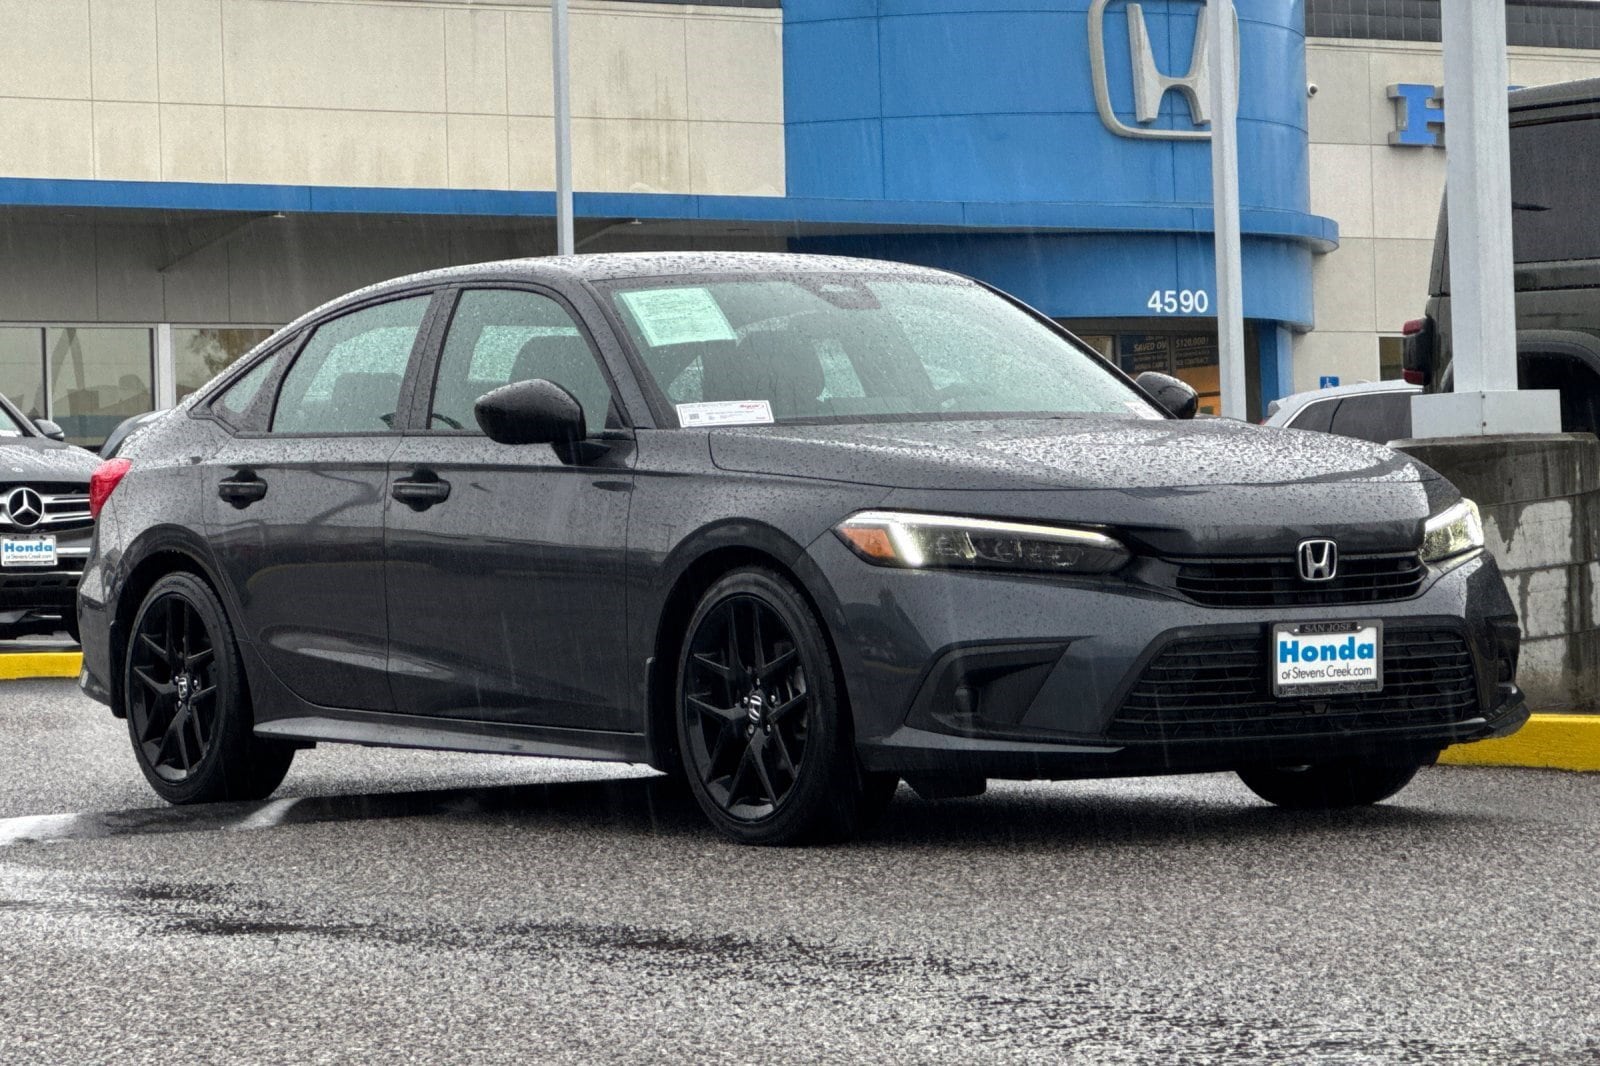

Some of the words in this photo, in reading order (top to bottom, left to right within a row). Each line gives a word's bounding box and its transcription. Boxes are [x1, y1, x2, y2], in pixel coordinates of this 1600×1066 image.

[1147, 290, 1209, 313] 4590
[1134, 343, 1155, 352] SAVED
[4, 542, 52, 552] Honda
[1304, 624, 1325, 633] SAN
[1327, 623, 1353, 633] JOSE
[1279, 636, 1374, 663] Honda
[1281, 667, 1292, 680] of
[1292, 666, 1325, 680] Stevens
[1326, 663, 1372, 678] Creek.com
